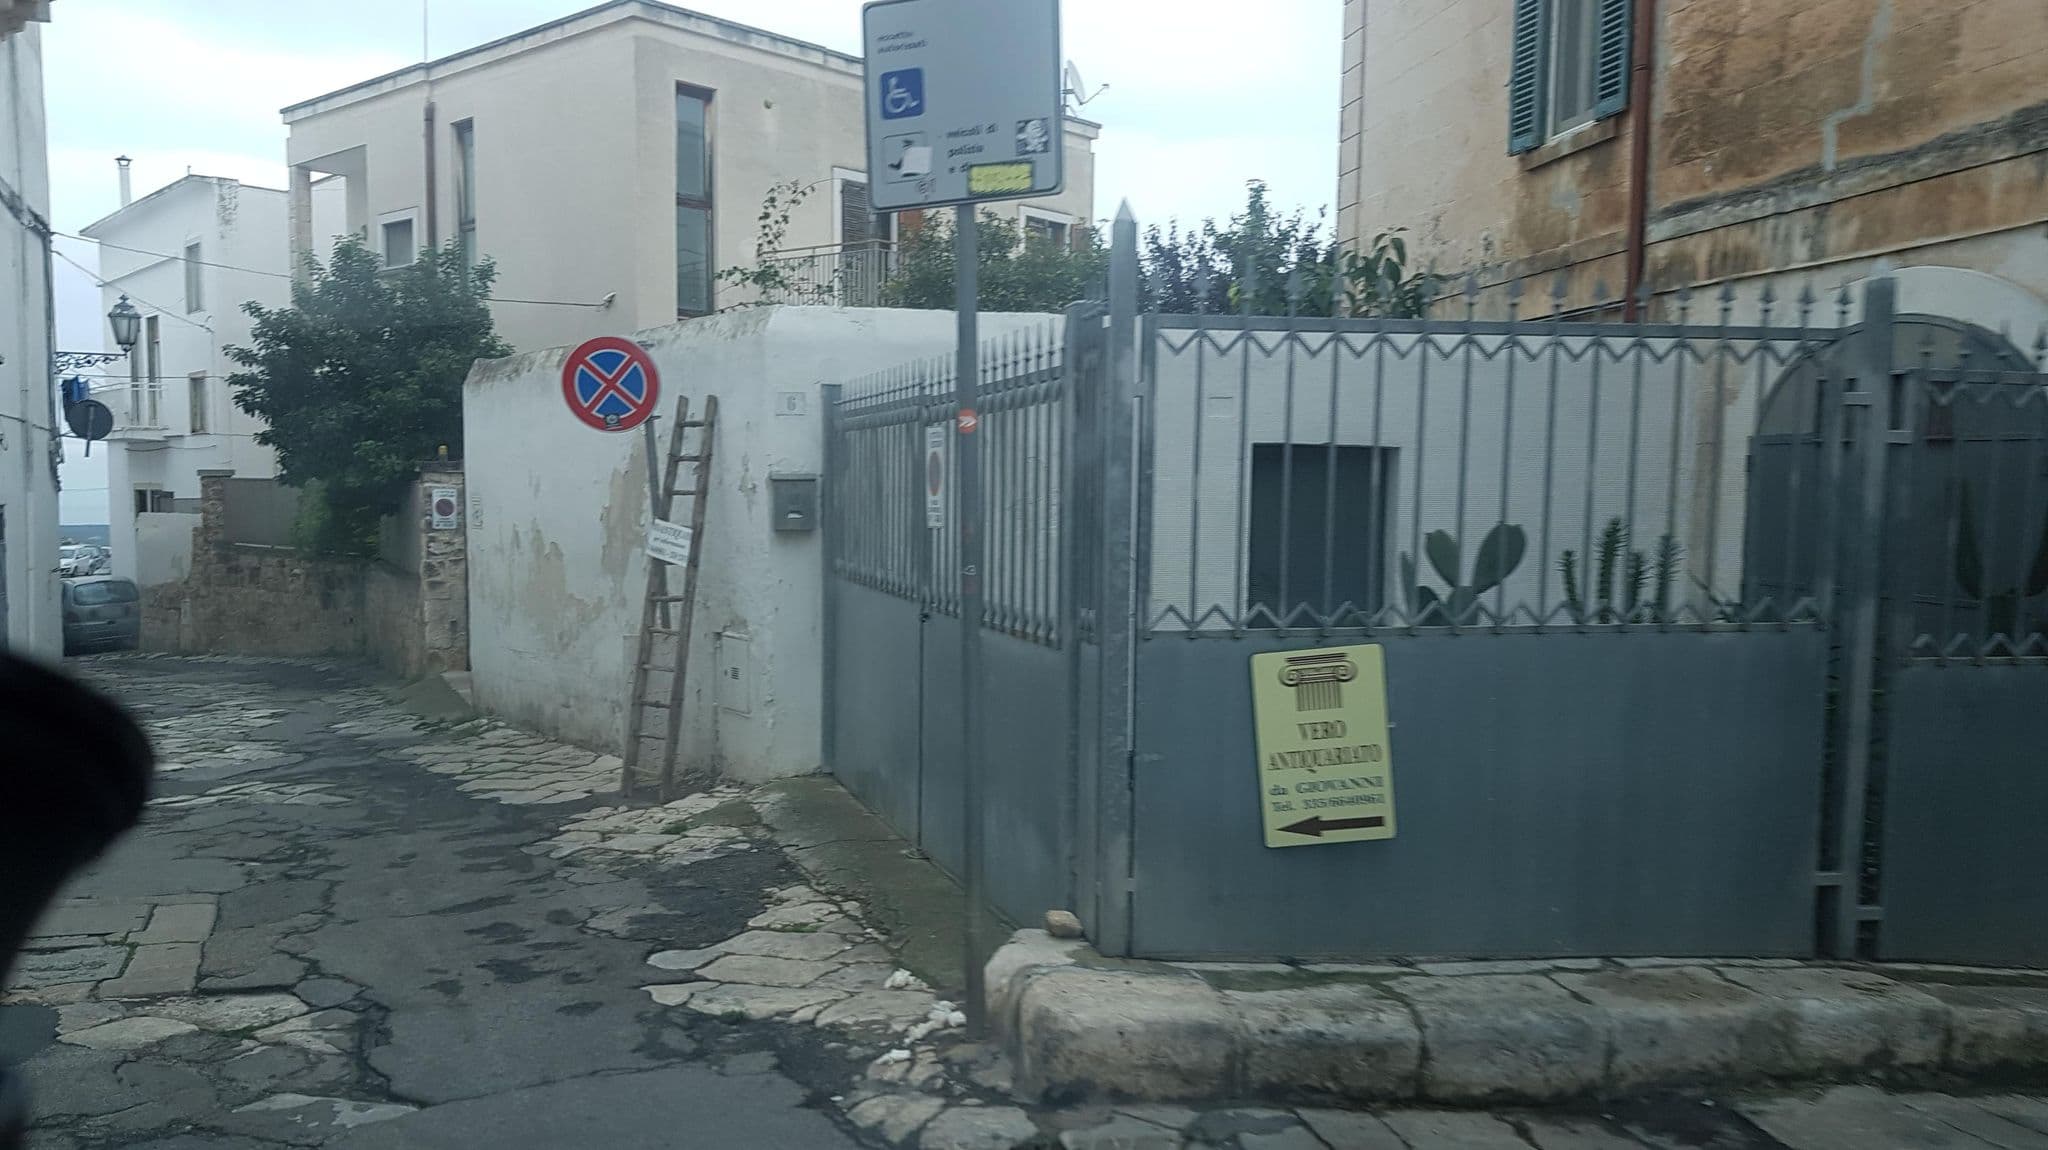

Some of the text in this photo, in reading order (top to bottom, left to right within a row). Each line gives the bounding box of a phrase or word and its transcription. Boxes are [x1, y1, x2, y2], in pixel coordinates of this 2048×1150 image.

[947, 144, 984, 158] polizia
[786, 395, 797, 411] 6
[1296, 720, 1347, 740] VERO
[1267, 744, 1383, 773] ANTIQUARIATO
[1269, 776, 1384, 795] da GIOVANNI
